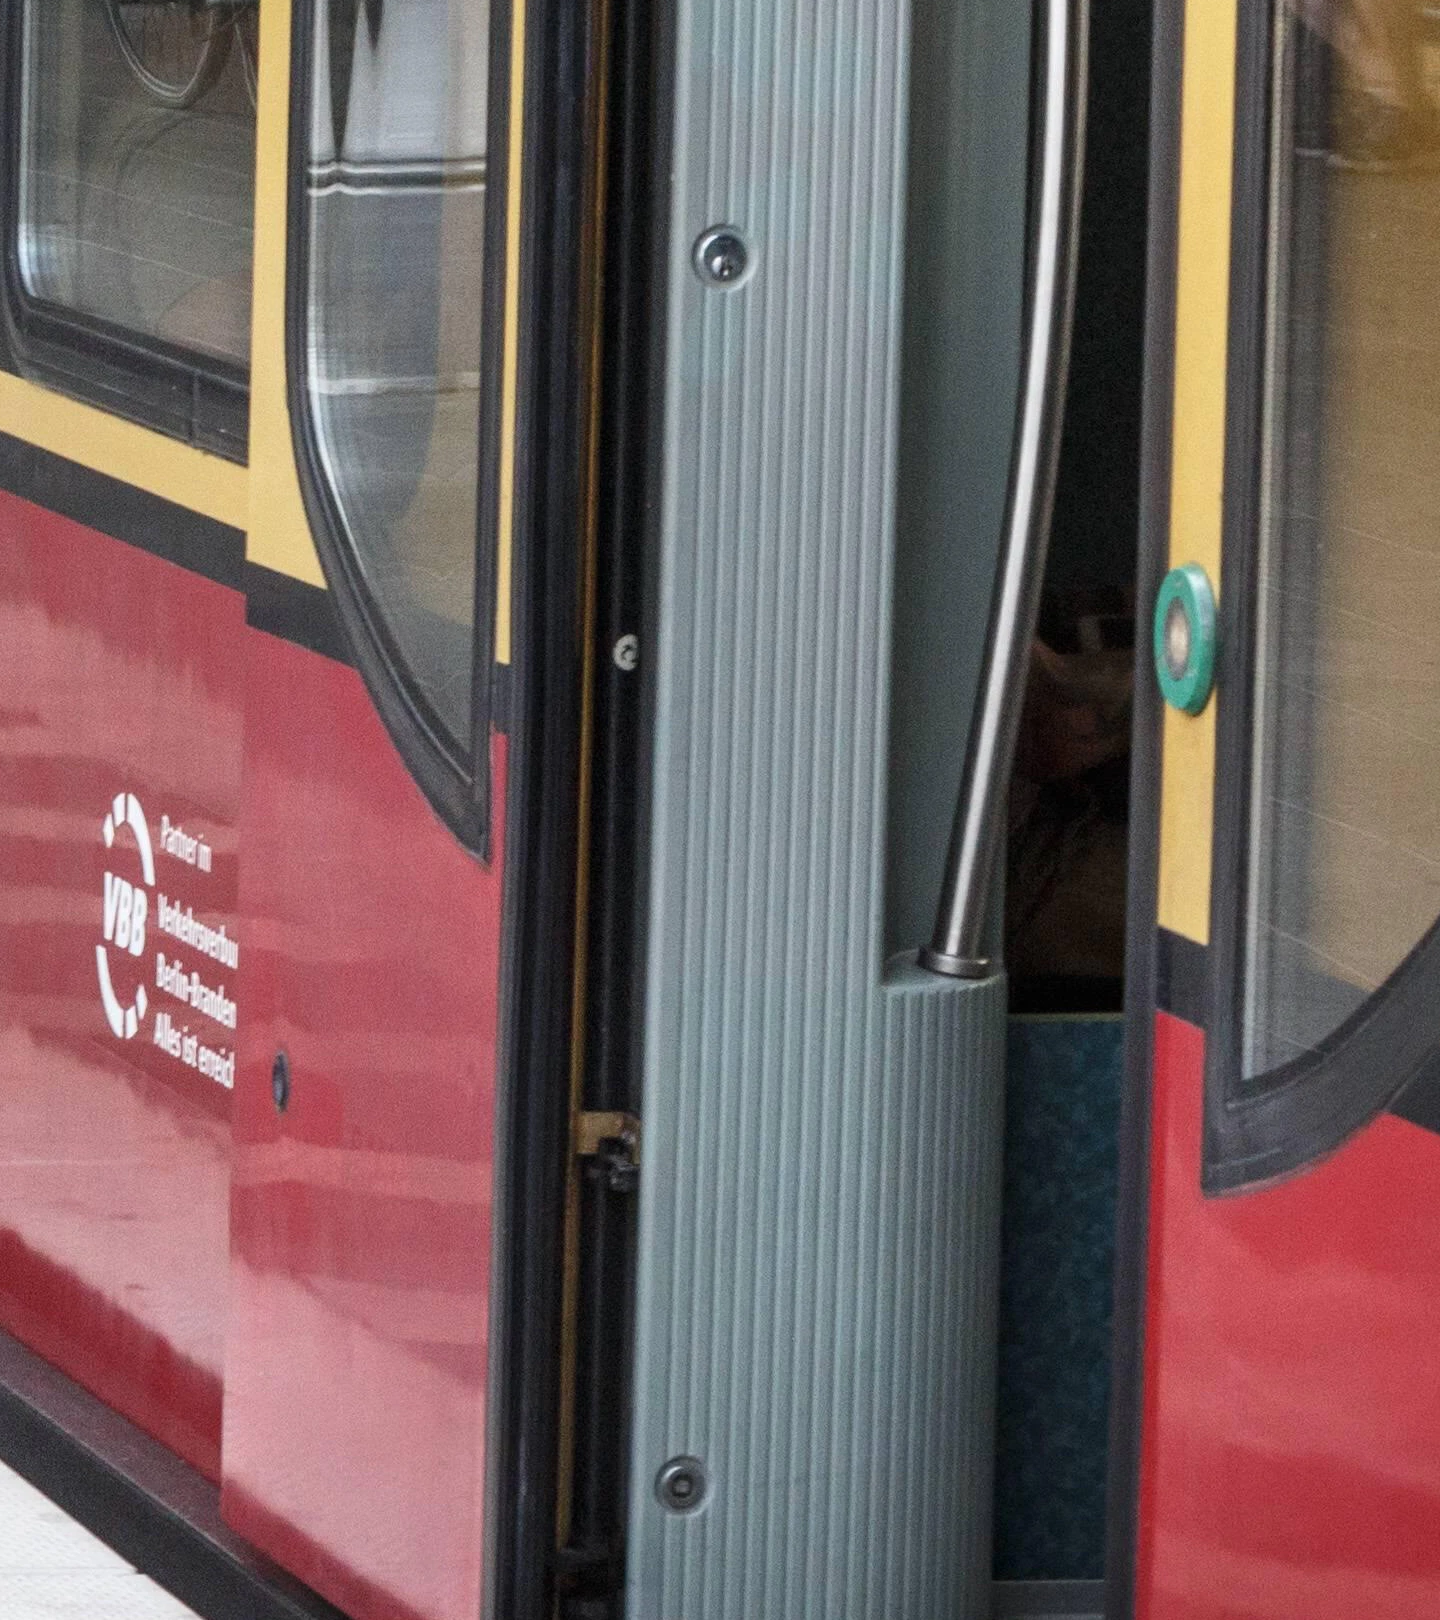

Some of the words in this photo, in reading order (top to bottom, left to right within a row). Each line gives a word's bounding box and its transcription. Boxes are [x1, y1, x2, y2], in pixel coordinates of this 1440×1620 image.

[103, 871, 148, 957] VBB
[153, 1012, 182, 1058] Alles
[182, 1025, 198, 1068] ist
